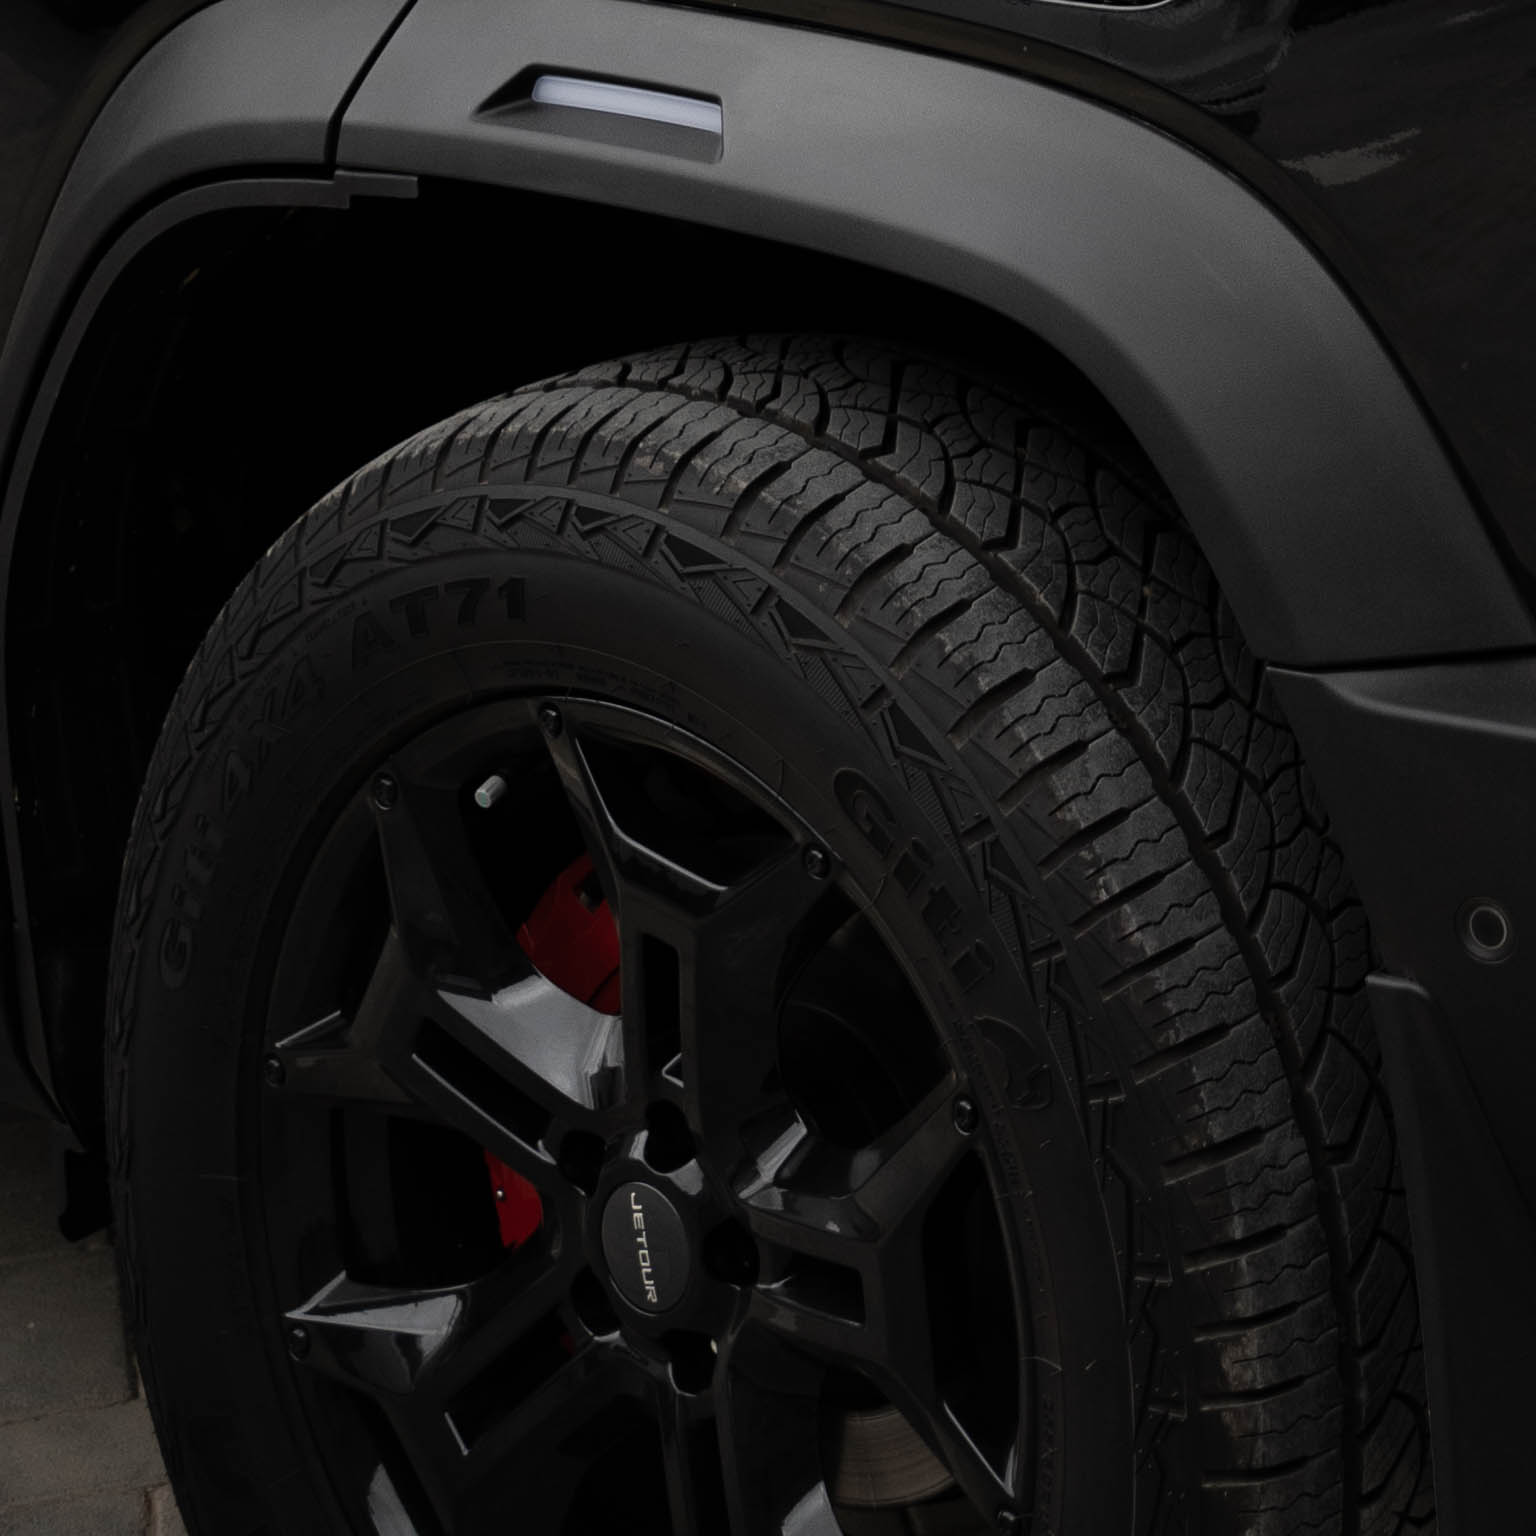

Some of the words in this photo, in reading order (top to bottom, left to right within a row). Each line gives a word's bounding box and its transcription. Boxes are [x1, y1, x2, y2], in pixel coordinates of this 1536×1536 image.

[351, 576, 528, 673] AT71
[832, 766, 996, 994] Giti
[630, 1191, 658, 1304] JETOUR
